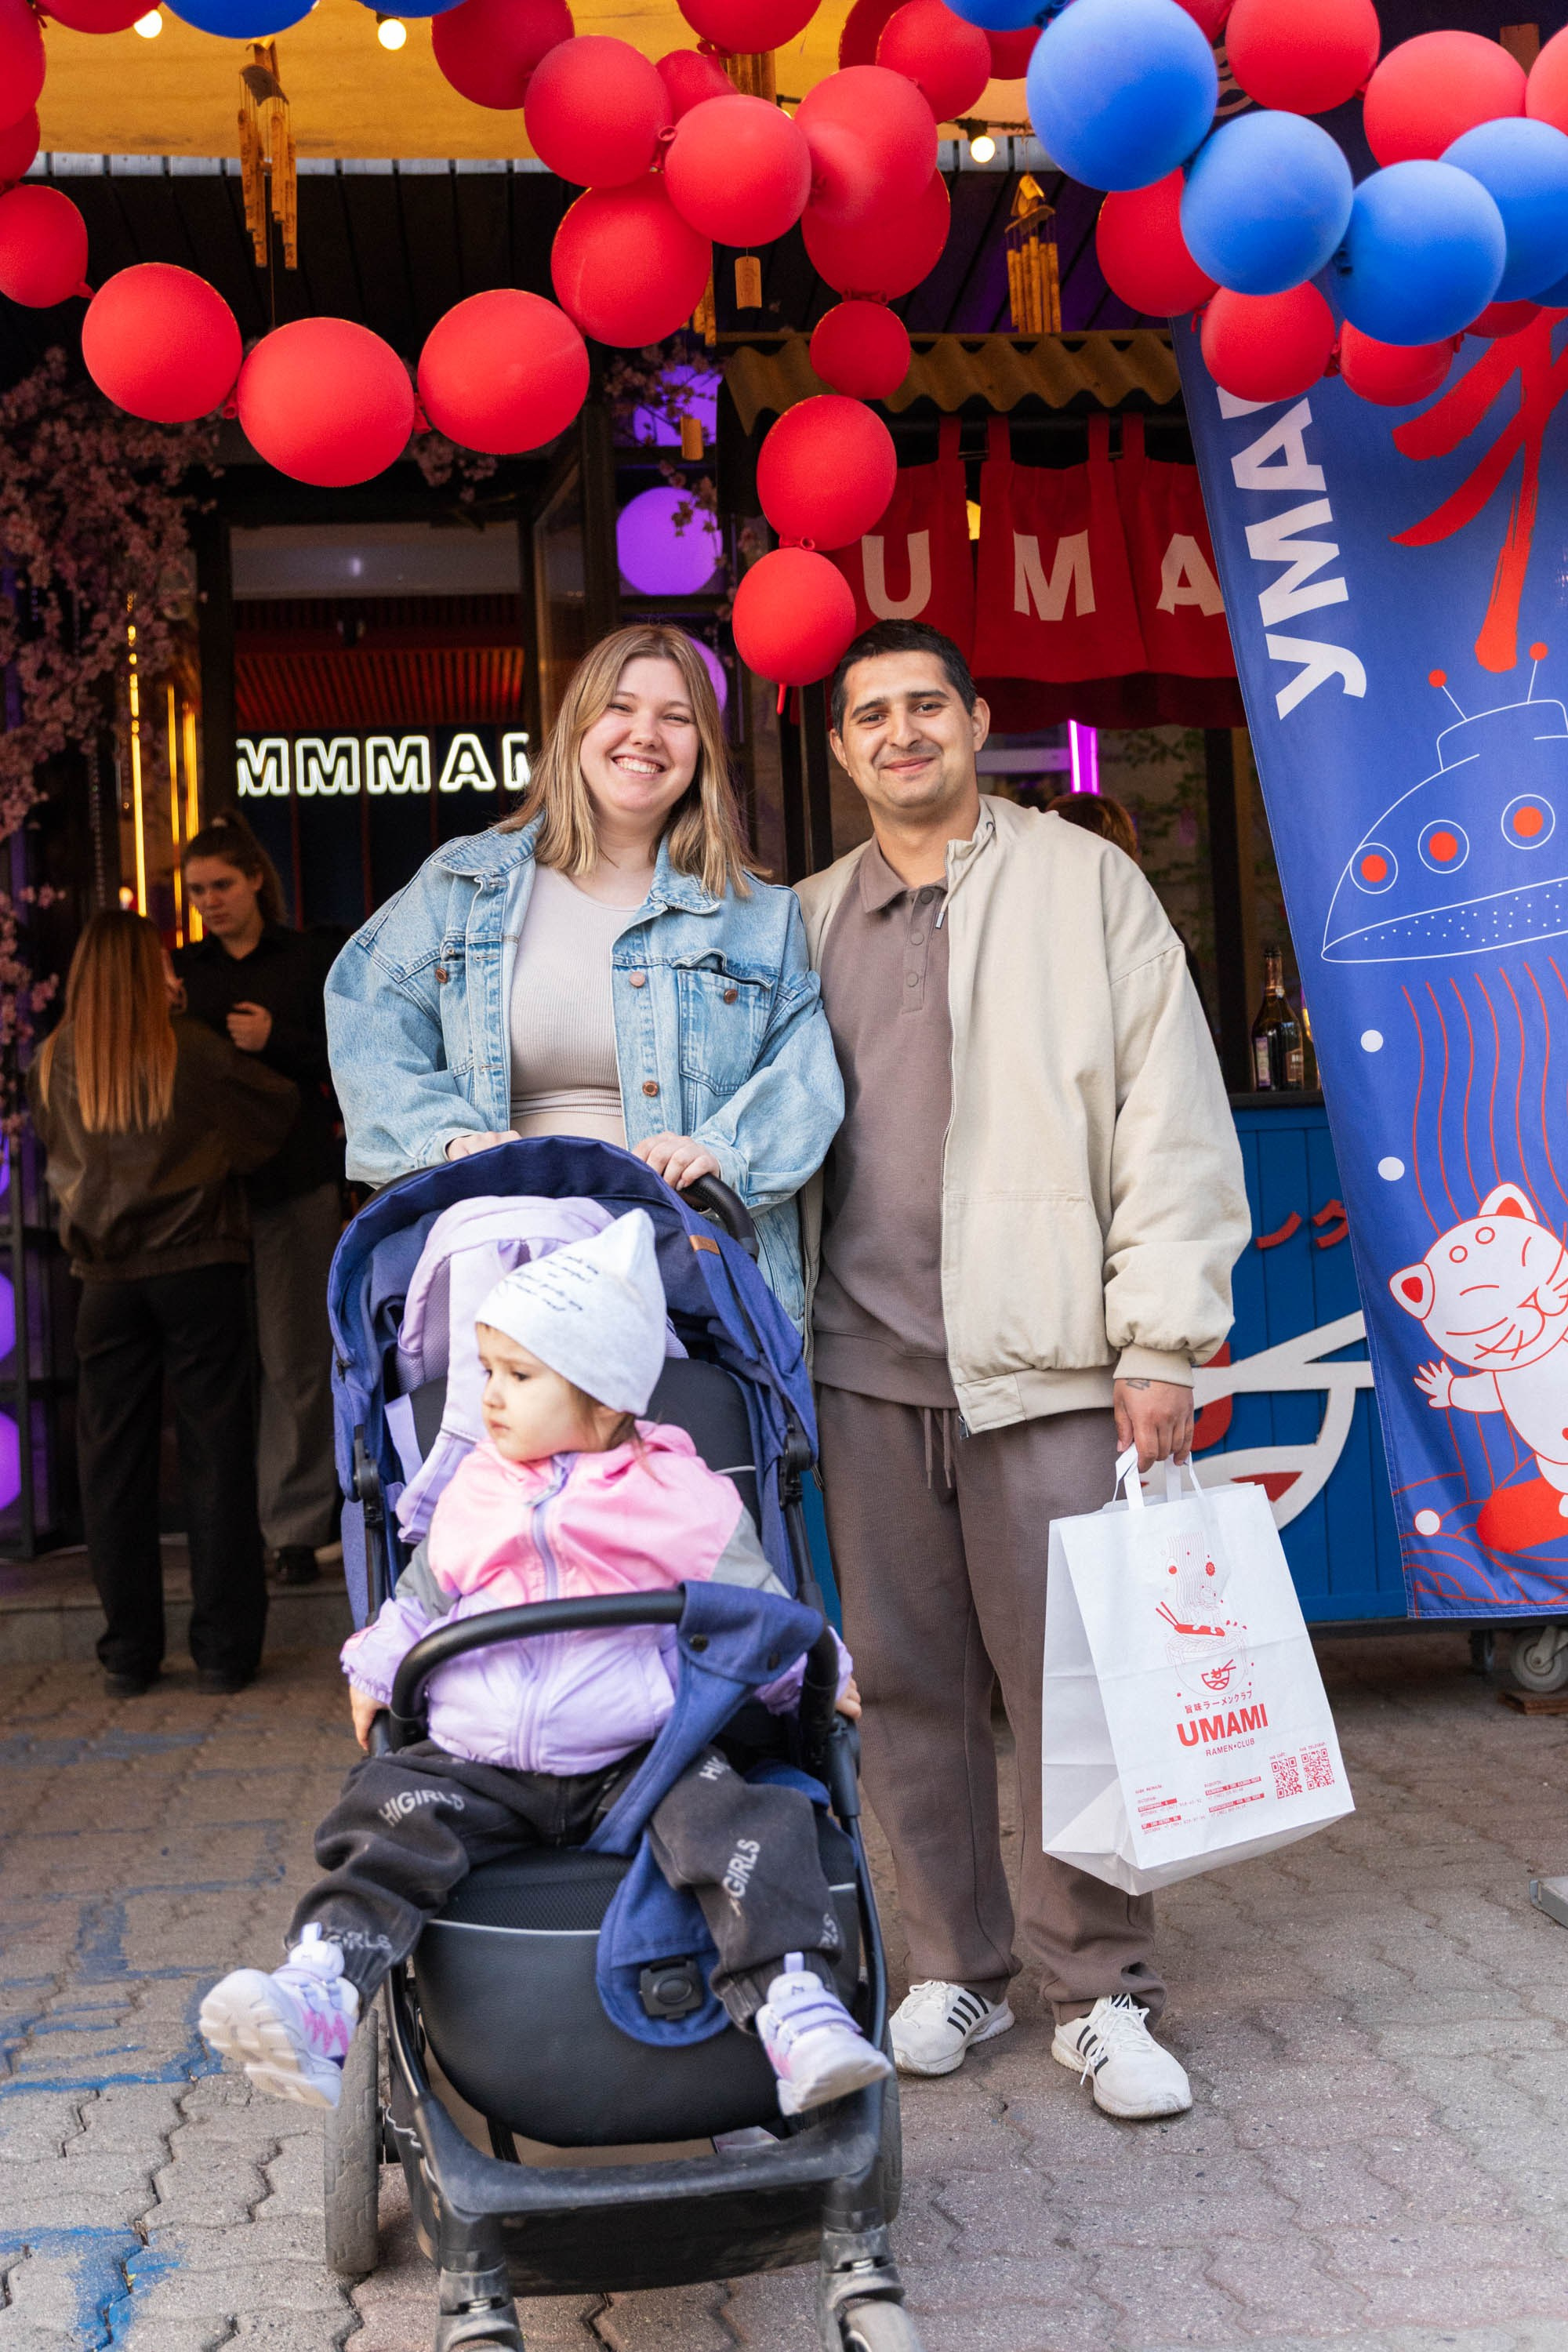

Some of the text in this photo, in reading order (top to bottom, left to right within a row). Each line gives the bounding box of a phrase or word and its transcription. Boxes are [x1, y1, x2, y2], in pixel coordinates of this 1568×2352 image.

[1217, 386, 1367, 720] УМА
[1185, 1690, 1253, 1714] 旨味ラーメンクラブ
[1177, 1703, 1269, 1747] UMAMI
